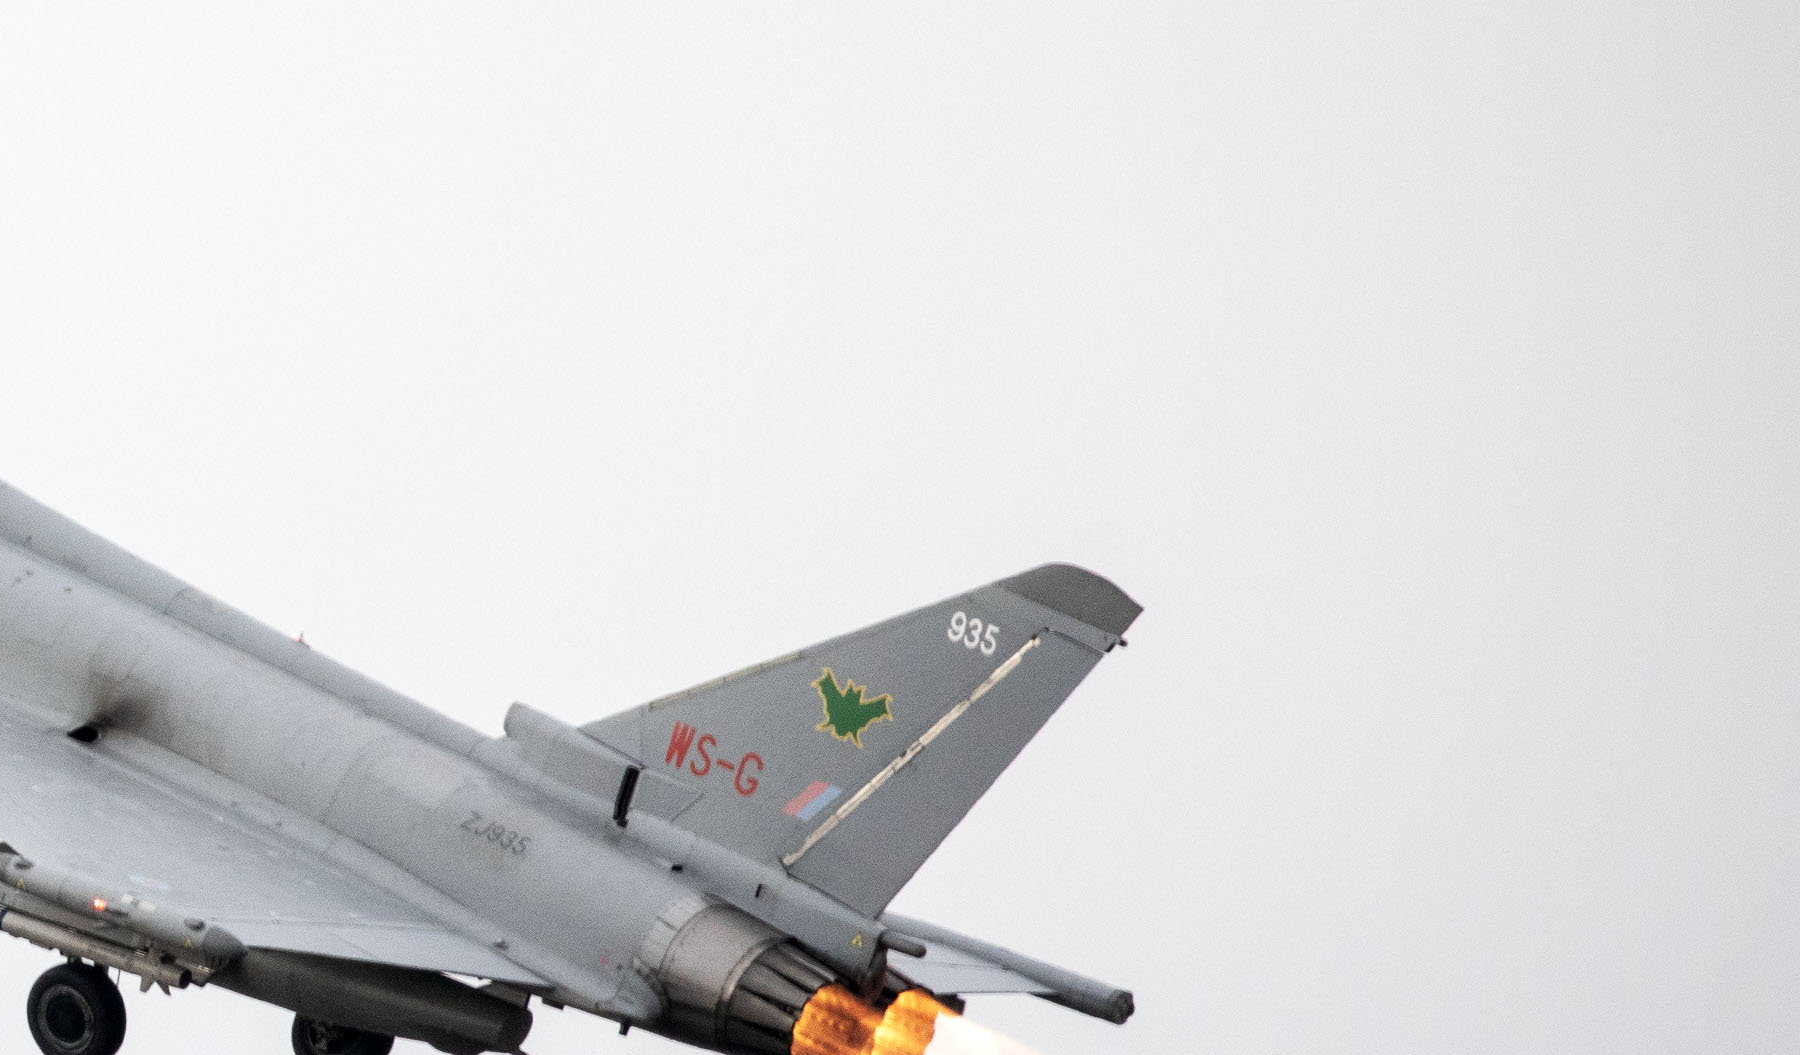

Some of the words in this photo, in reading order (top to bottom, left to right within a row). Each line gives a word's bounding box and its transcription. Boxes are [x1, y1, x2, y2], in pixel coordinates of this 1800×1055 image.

[947, 610, 1000, 656] 935
[665, 720, 764, 798] WS-G
[460, 810, 533, 857] ZJ935
